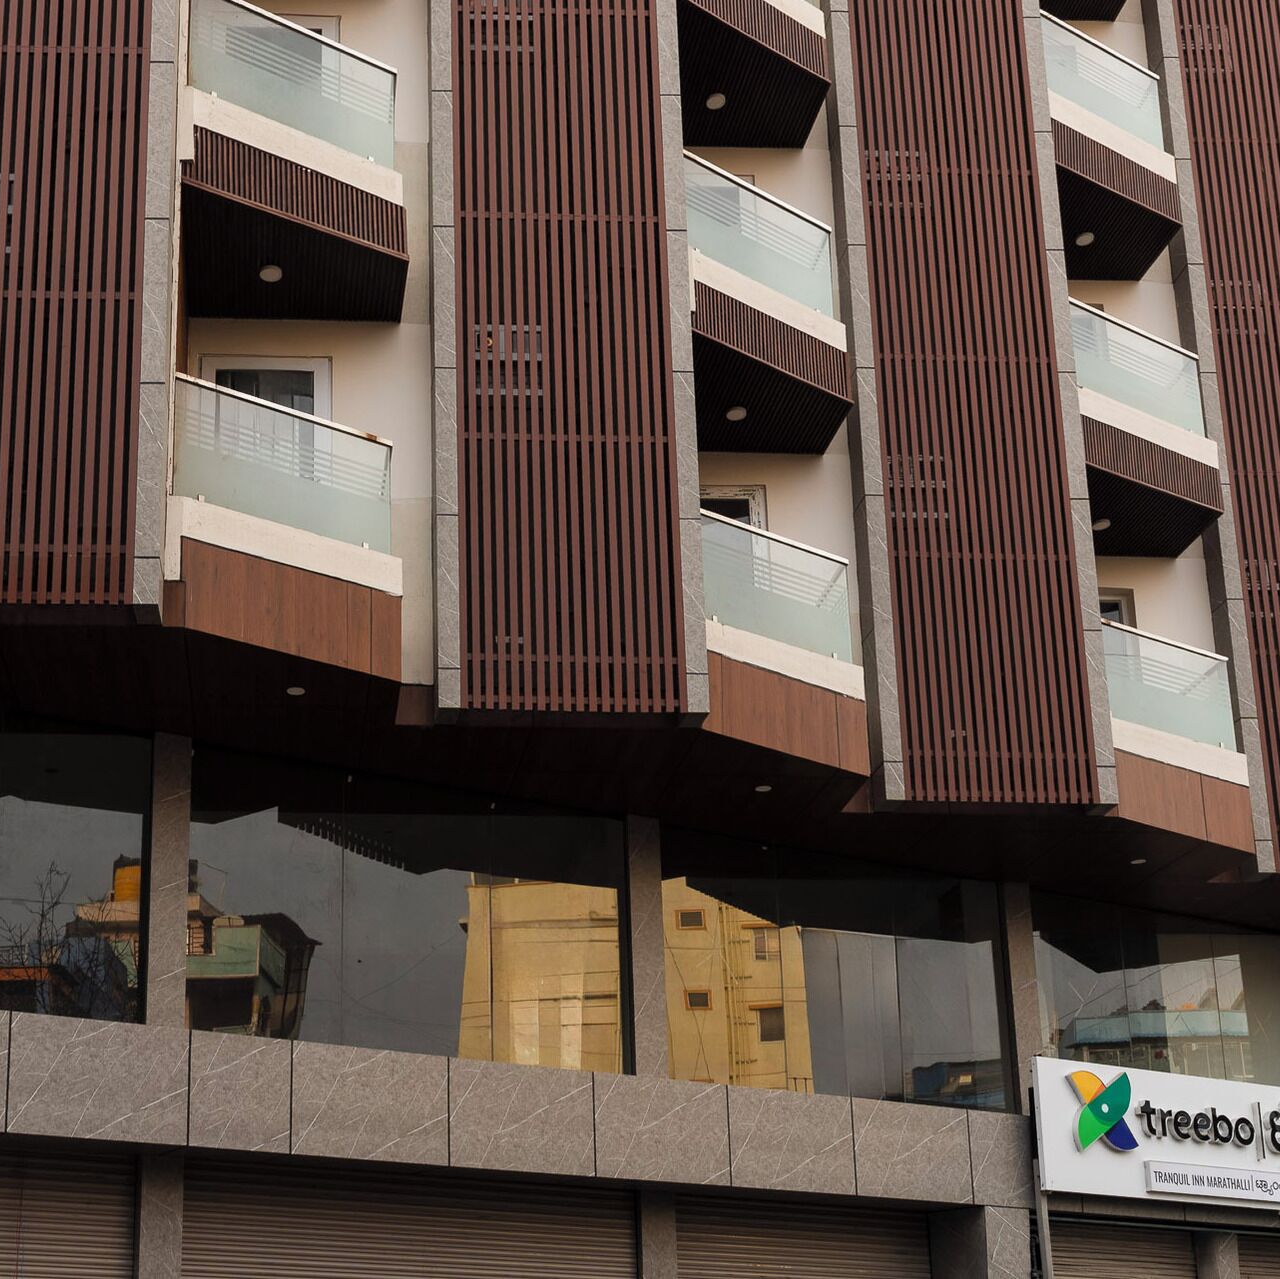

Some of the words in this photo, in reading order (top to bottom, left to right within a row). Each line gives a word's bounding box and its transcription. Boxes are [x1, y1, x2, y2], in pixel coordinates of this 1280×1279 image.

[1138, 1099, 1255, 1146] treebo
[1153, 1171, 1190, 1186] TRANQUIL
[1192, 1175, 1205, 1187] INN
[1207, 1176, 1250, 1191] MARATHALLI
